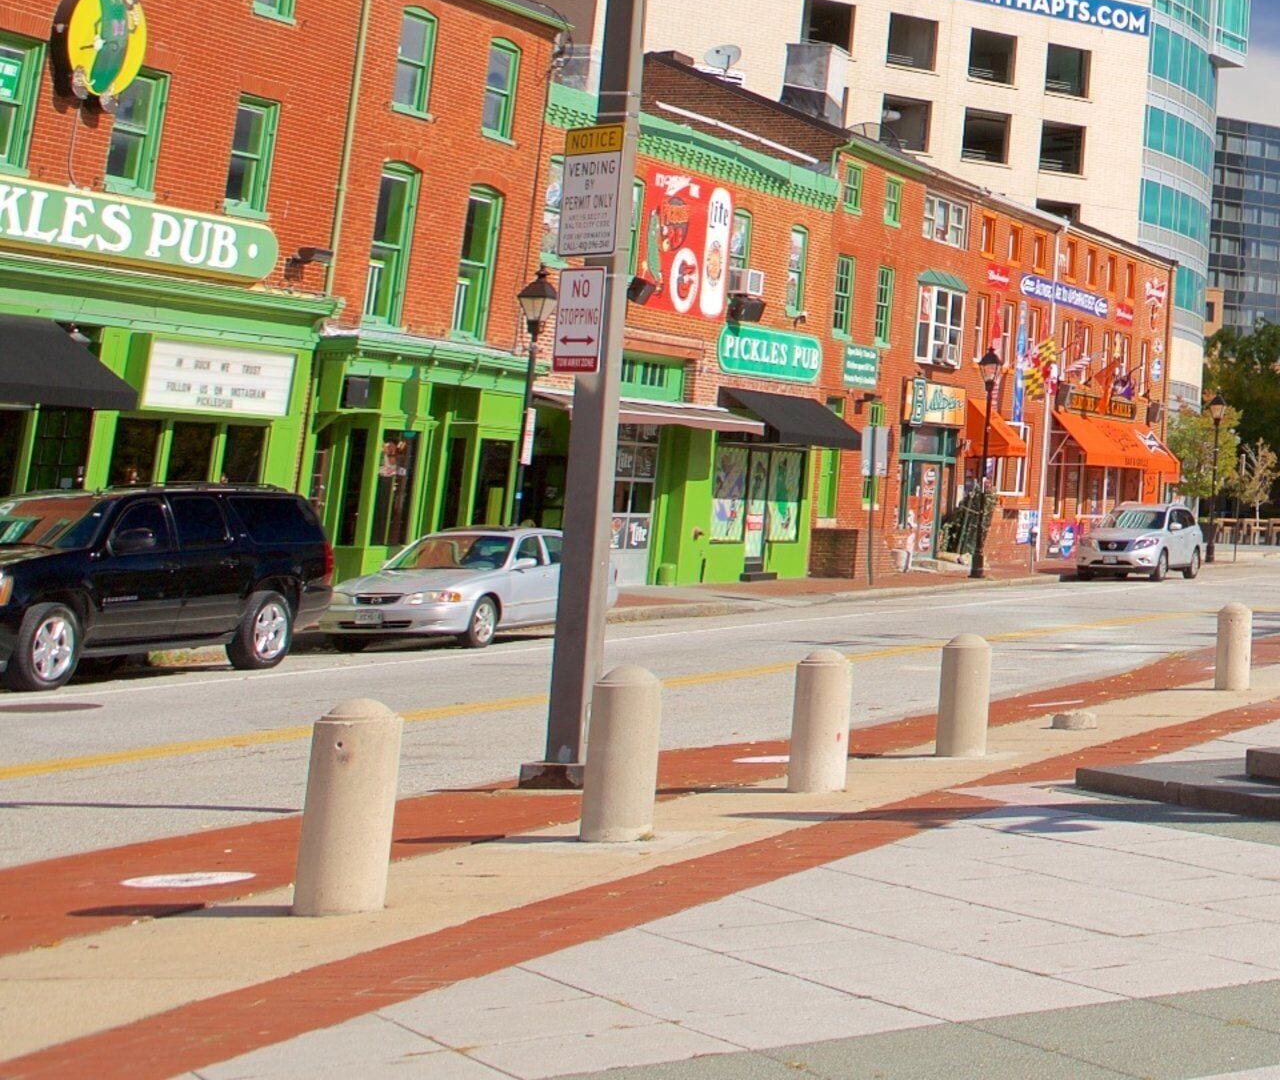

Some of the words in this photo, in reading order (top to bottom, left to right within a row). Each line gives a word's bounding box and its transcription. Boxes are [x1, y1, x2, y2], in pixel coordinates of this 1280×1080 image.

[571, 131, 617, 149] NOTICE
[568, 159, 616, 178] VENDING
[584, 178, 595, 191] BY
[564, 195, 591, 211] PERMIT
[592, 193, 614, 209] ONLY
[709, 200, 729, 229] Lite
[145, 212, 239, 269] PUB
[571, 279, 591, 299] NO
[559, 307, 599, 326] STOPPING
[723, 334, 789, 366] PICKLES
[792, 344, 820, 370] PUB
[241, 363, 262, 376] TRUST
[165, 381, 191, 393] FOLLOW
[199, 384, 208, 394] US
[214, 385, 223, 395] ON
[230, 387, 267, 400] INSTAGRAM
[629, 522, 648, 546] Lite
